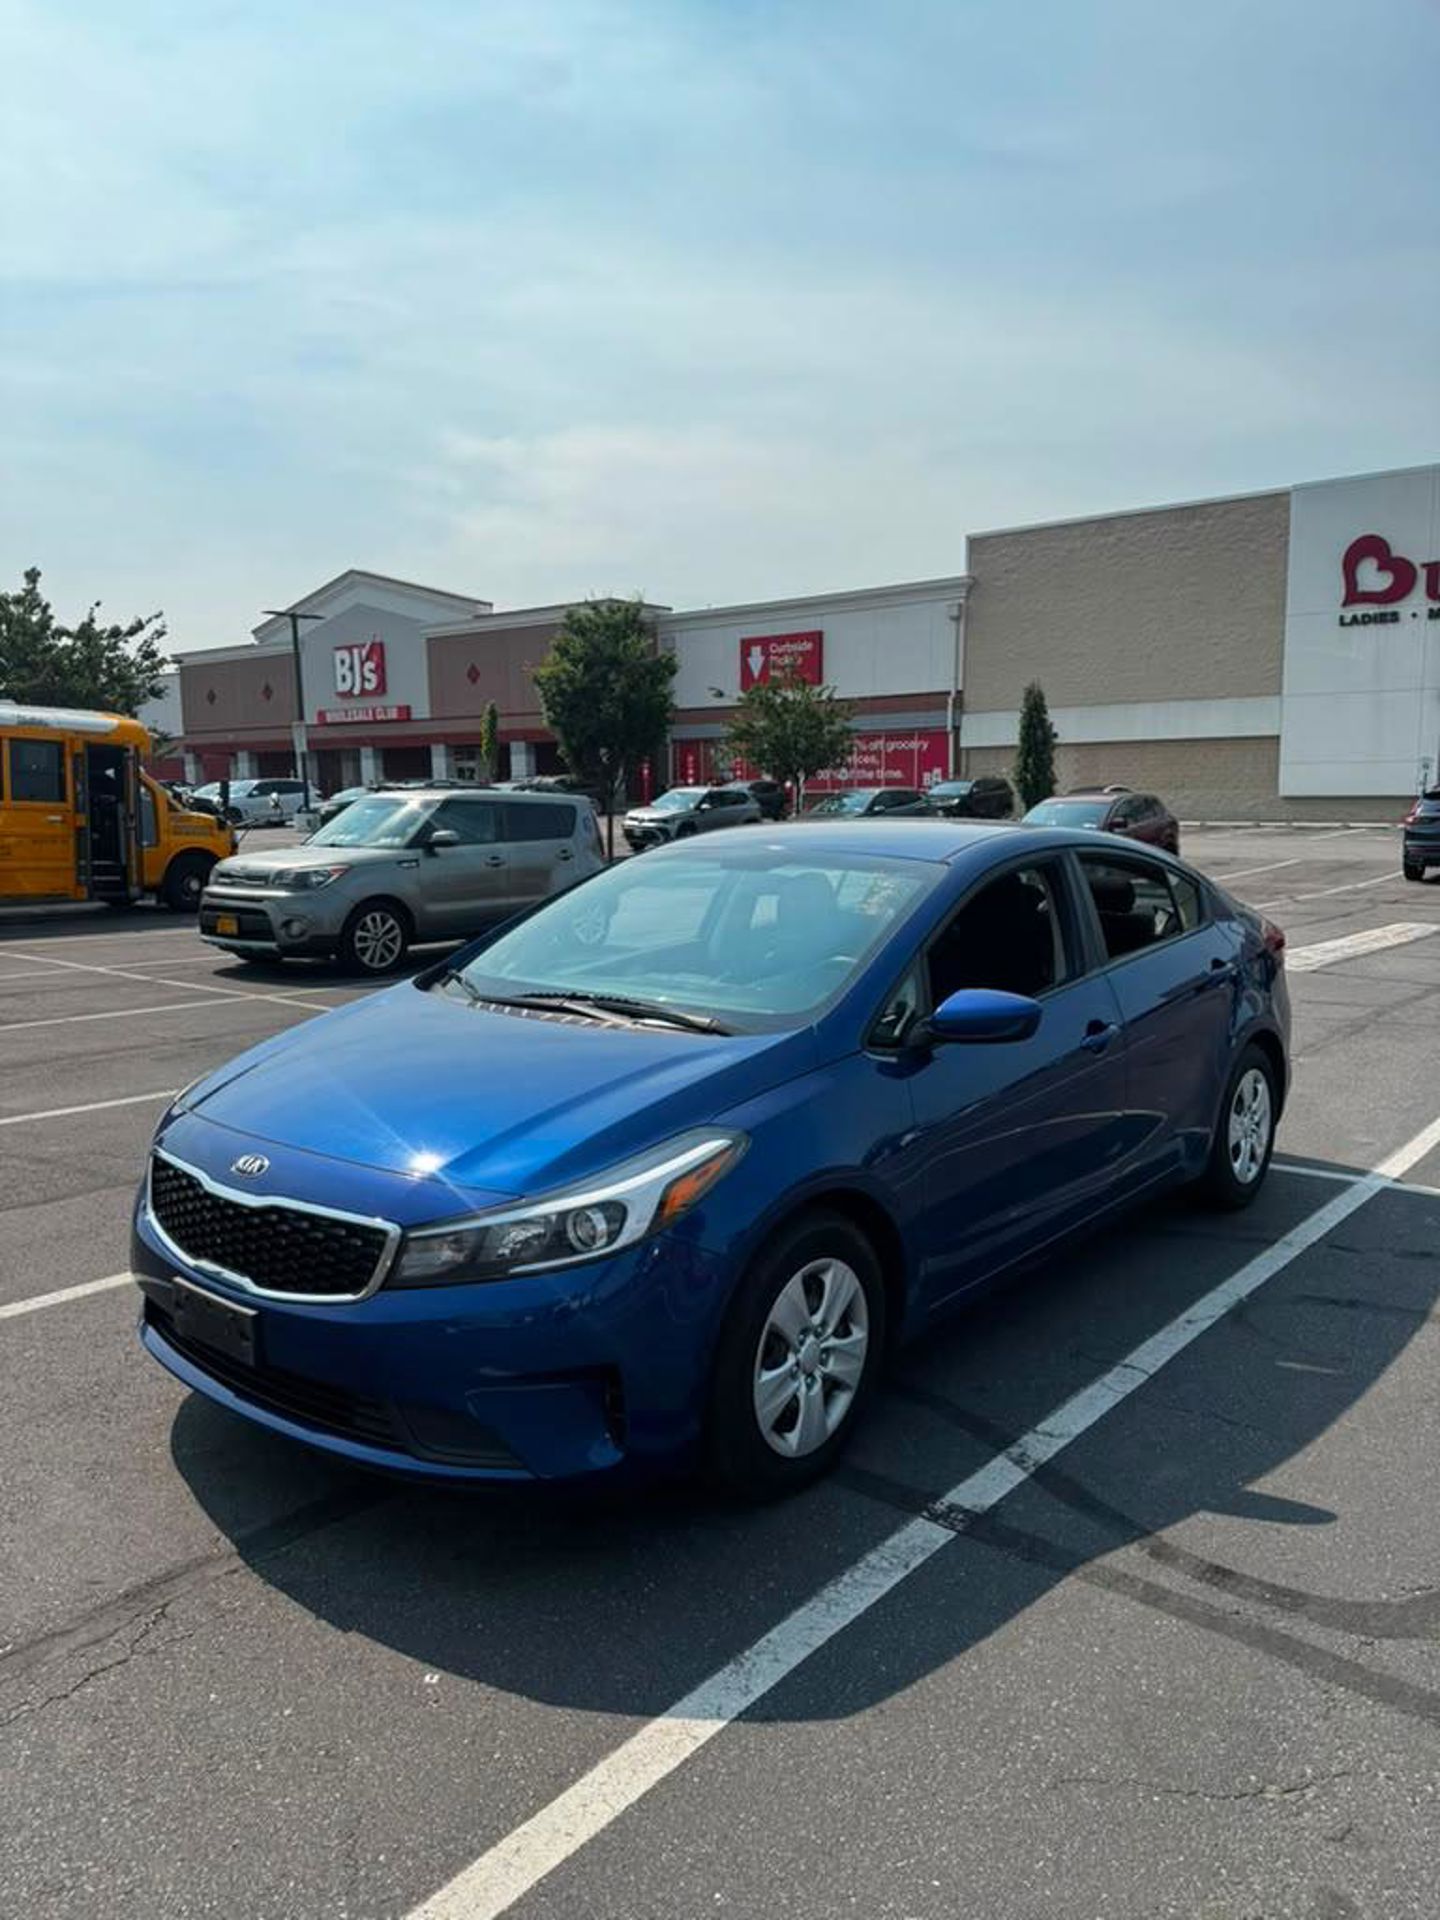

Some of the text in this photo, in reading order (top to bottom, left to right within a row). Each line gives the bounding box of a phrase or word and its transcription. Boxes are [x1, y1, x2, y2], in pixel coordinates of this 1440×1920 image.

[1339, 611, 1400, 627] LADIES
[769, 641, 814, 655] Curbside
[335, 642, 378, 696] BJ's
[326, 707, 398, 723] WHOLESALE CLUB
[886, 740, 929, 752] grocery
